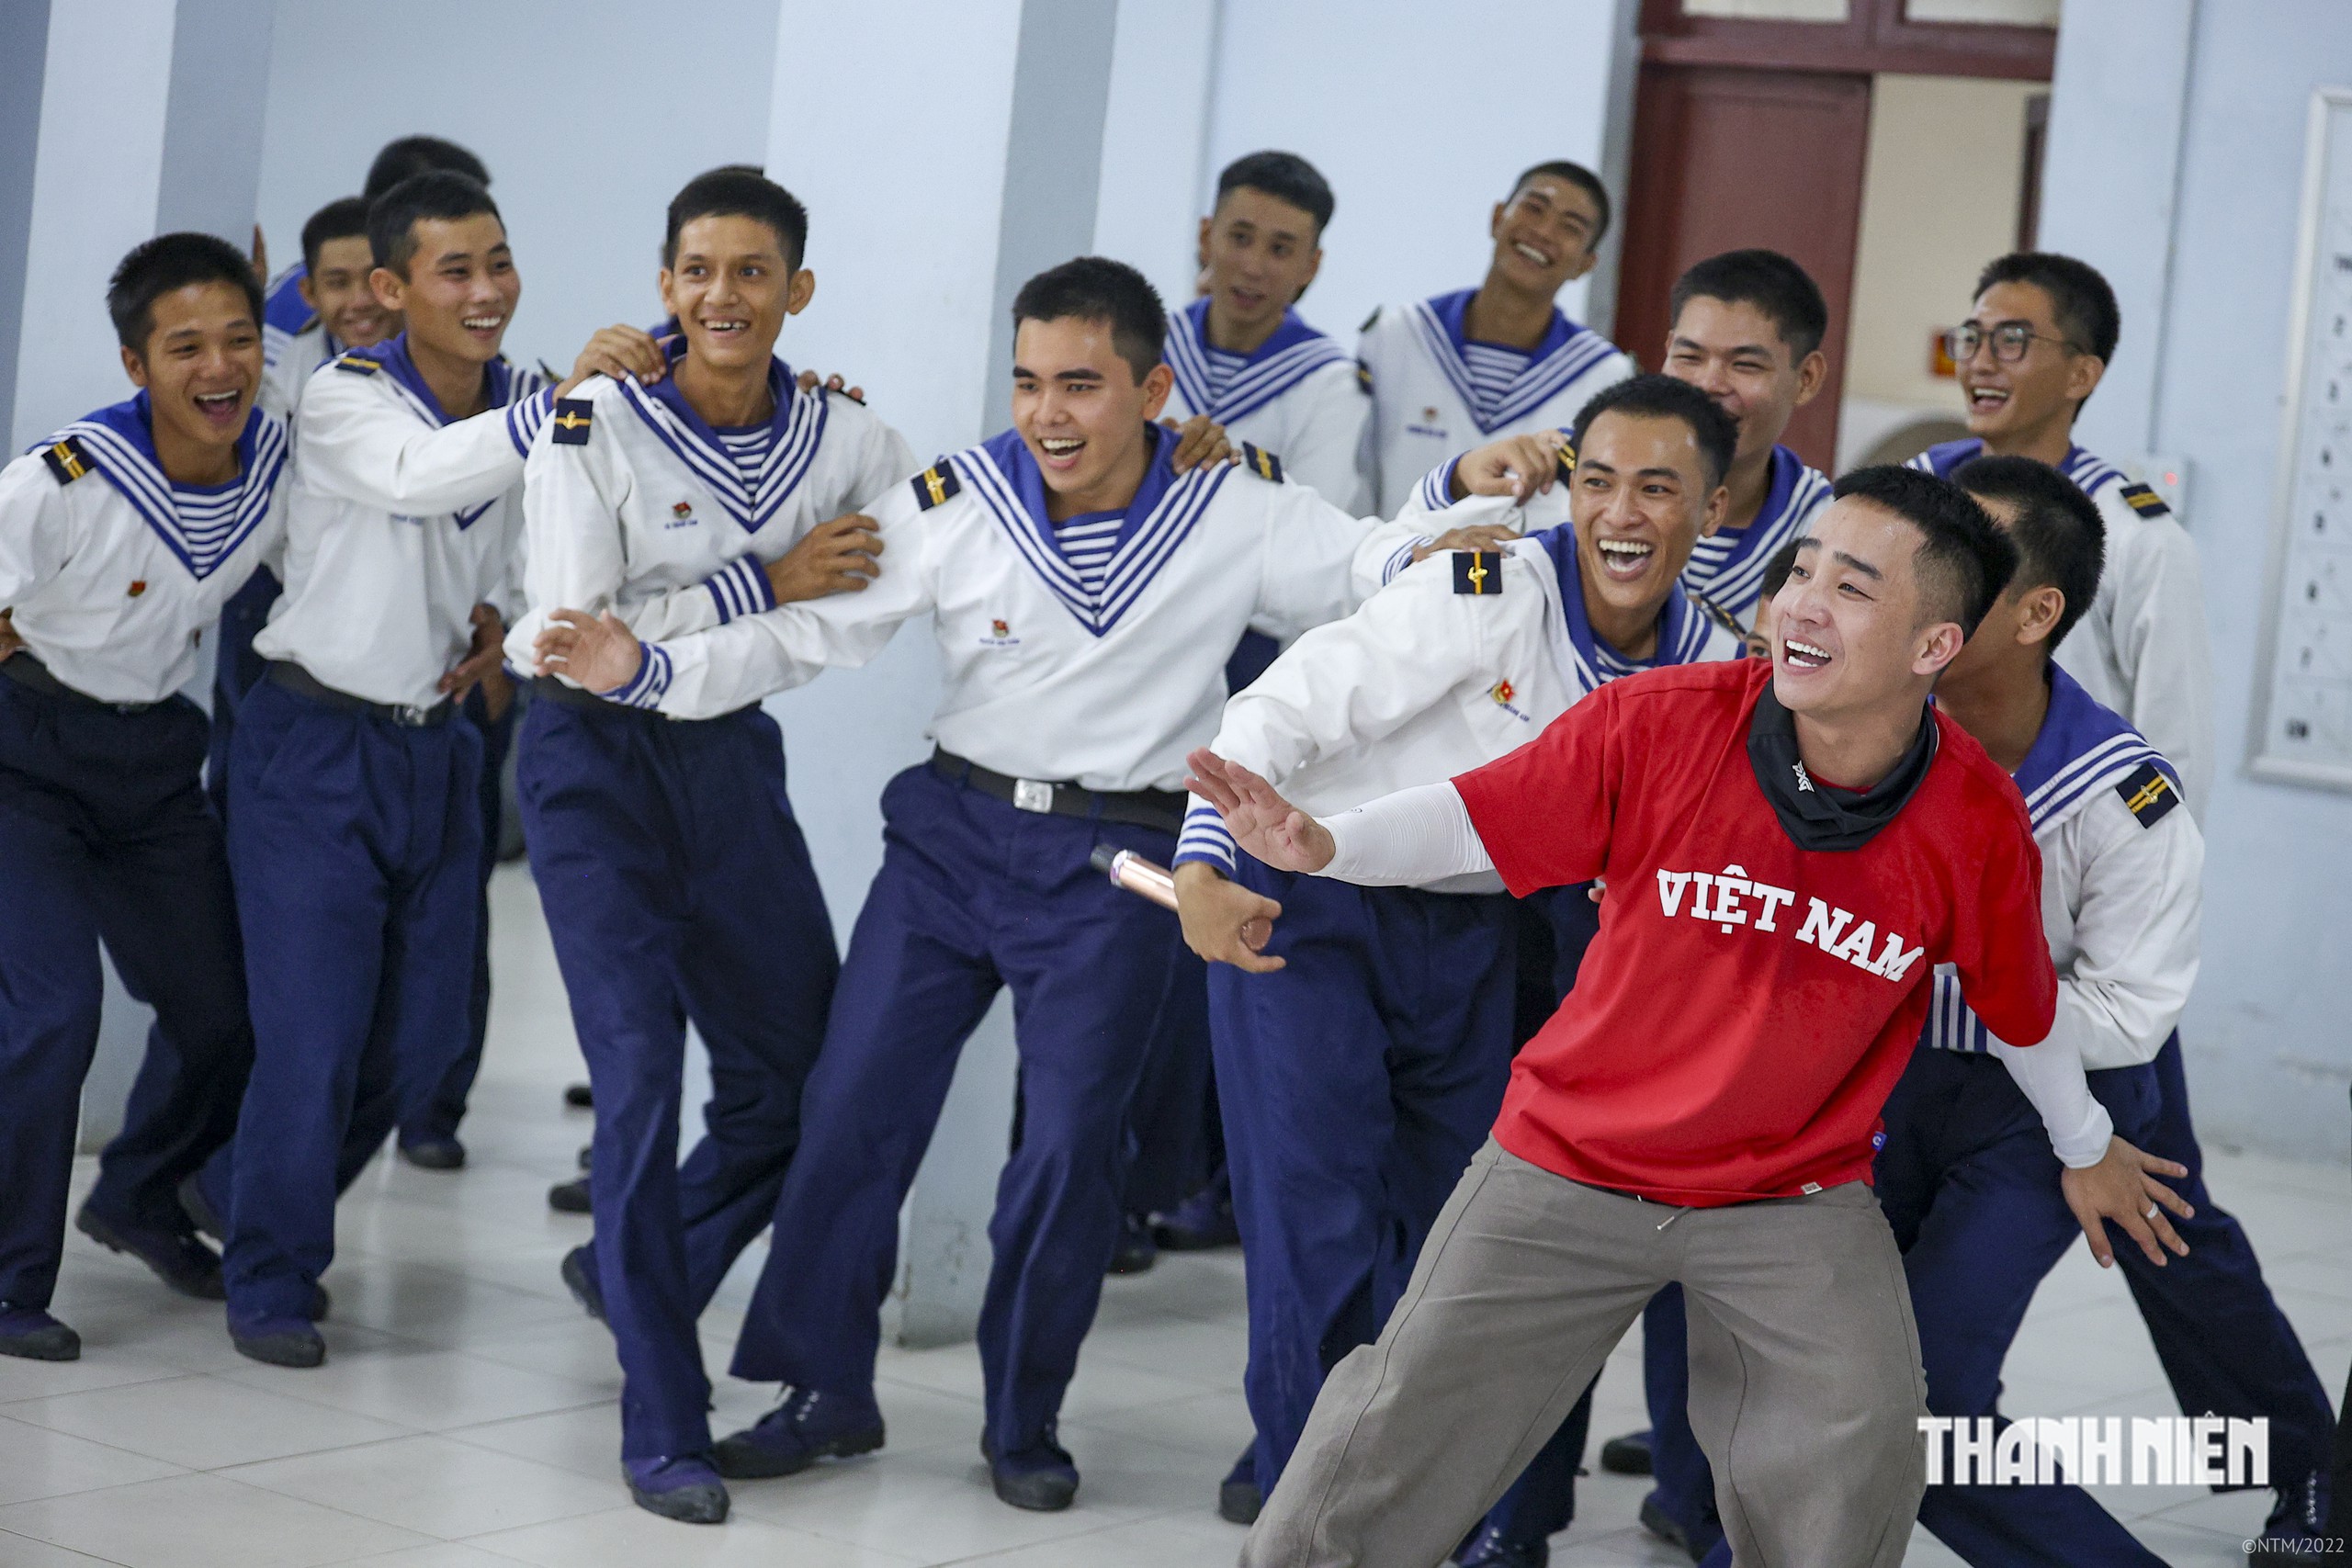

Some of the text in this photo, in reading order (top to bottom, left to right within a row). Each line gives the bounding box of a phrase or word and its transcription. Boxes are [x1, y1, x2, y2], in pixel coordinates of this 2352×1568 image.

[1792, 760, 1815, 793] PXG
[1657, 863, 1925, 982] VIỆT NAM
